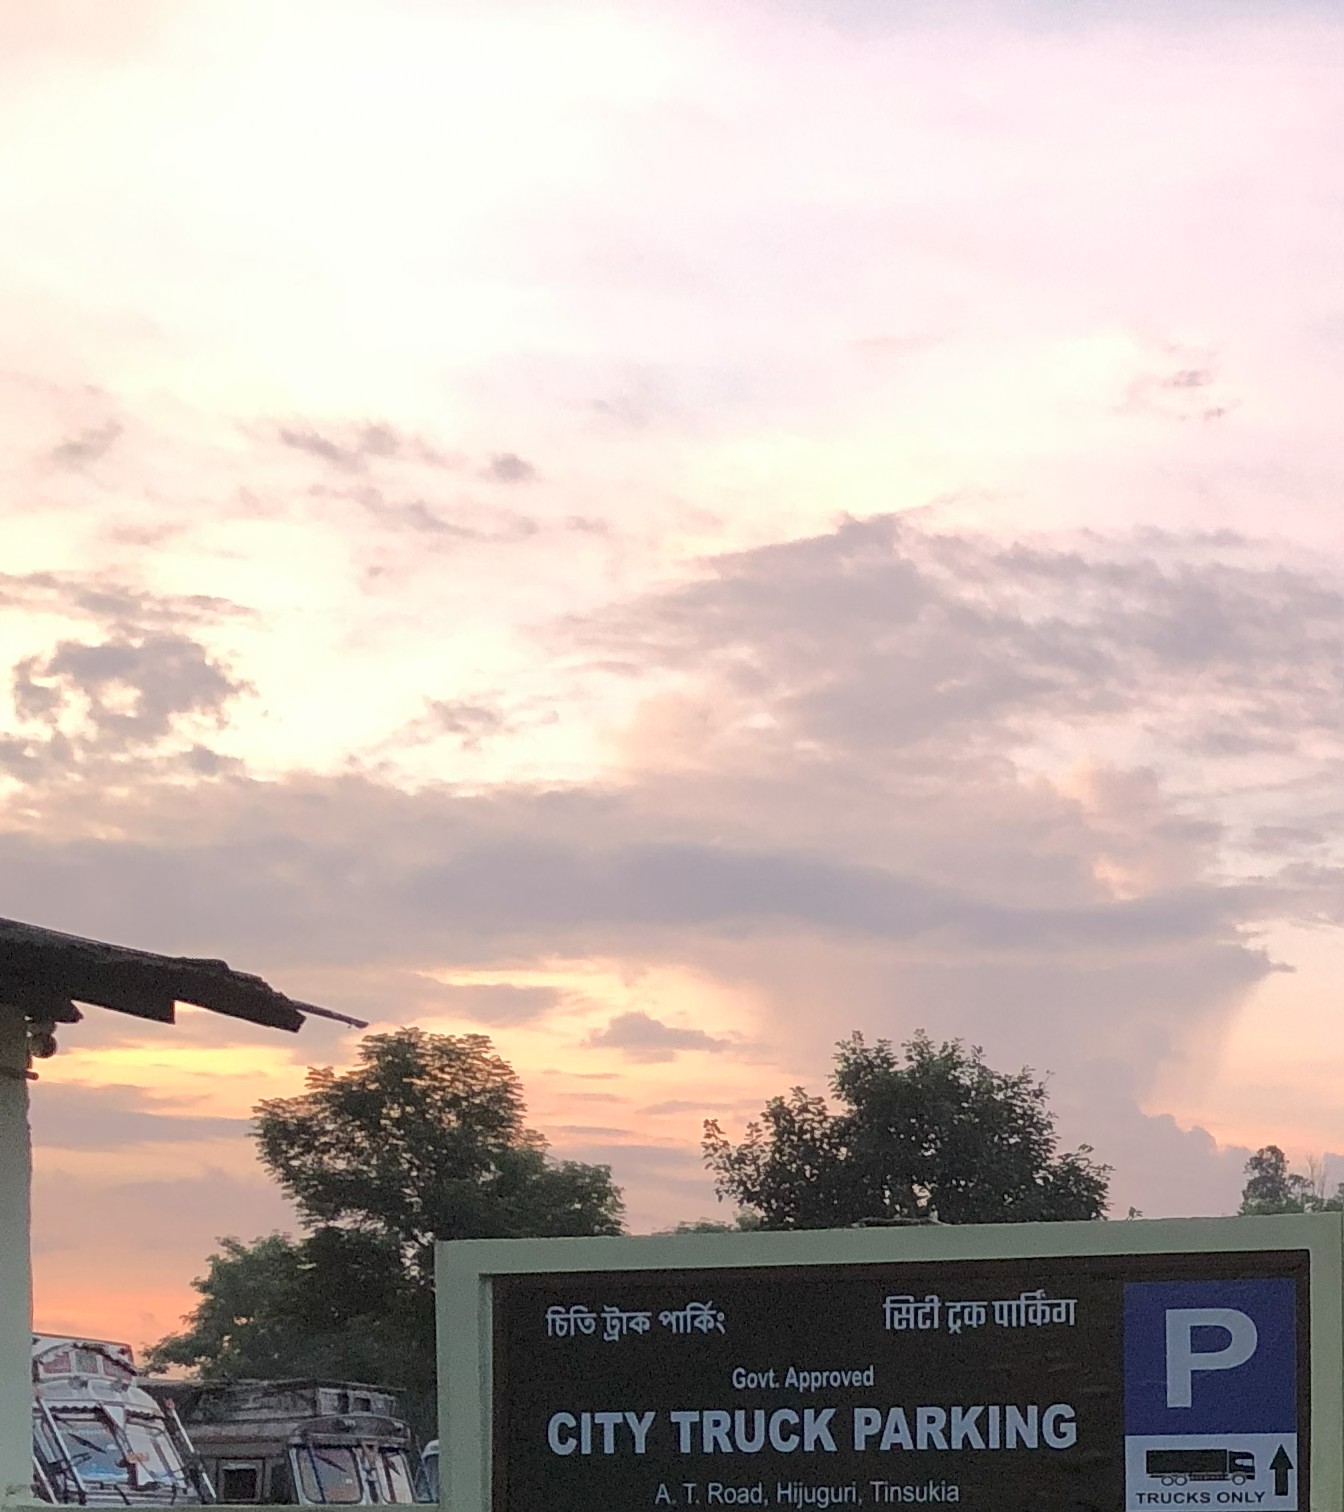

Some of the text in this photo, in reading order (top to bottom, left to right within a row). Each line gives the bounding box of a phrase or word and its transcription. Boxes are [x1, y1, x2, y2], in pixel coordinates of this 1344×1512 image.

[883, 1289, 1078, 1334] सिटी ट्रक पार्किंग
[1166, 1308, 1257, 1408] P
[732, 1365, 874, 1392] Govt. Approved
[548, 1404, 1077, 1455] CITY TRUCK PARKING
[655, 1481, 960, 1508] A. T. Road, Hijuguri, Tinsukia
[1136, 1491, 1266, 1504] TRUCKS ONLY
